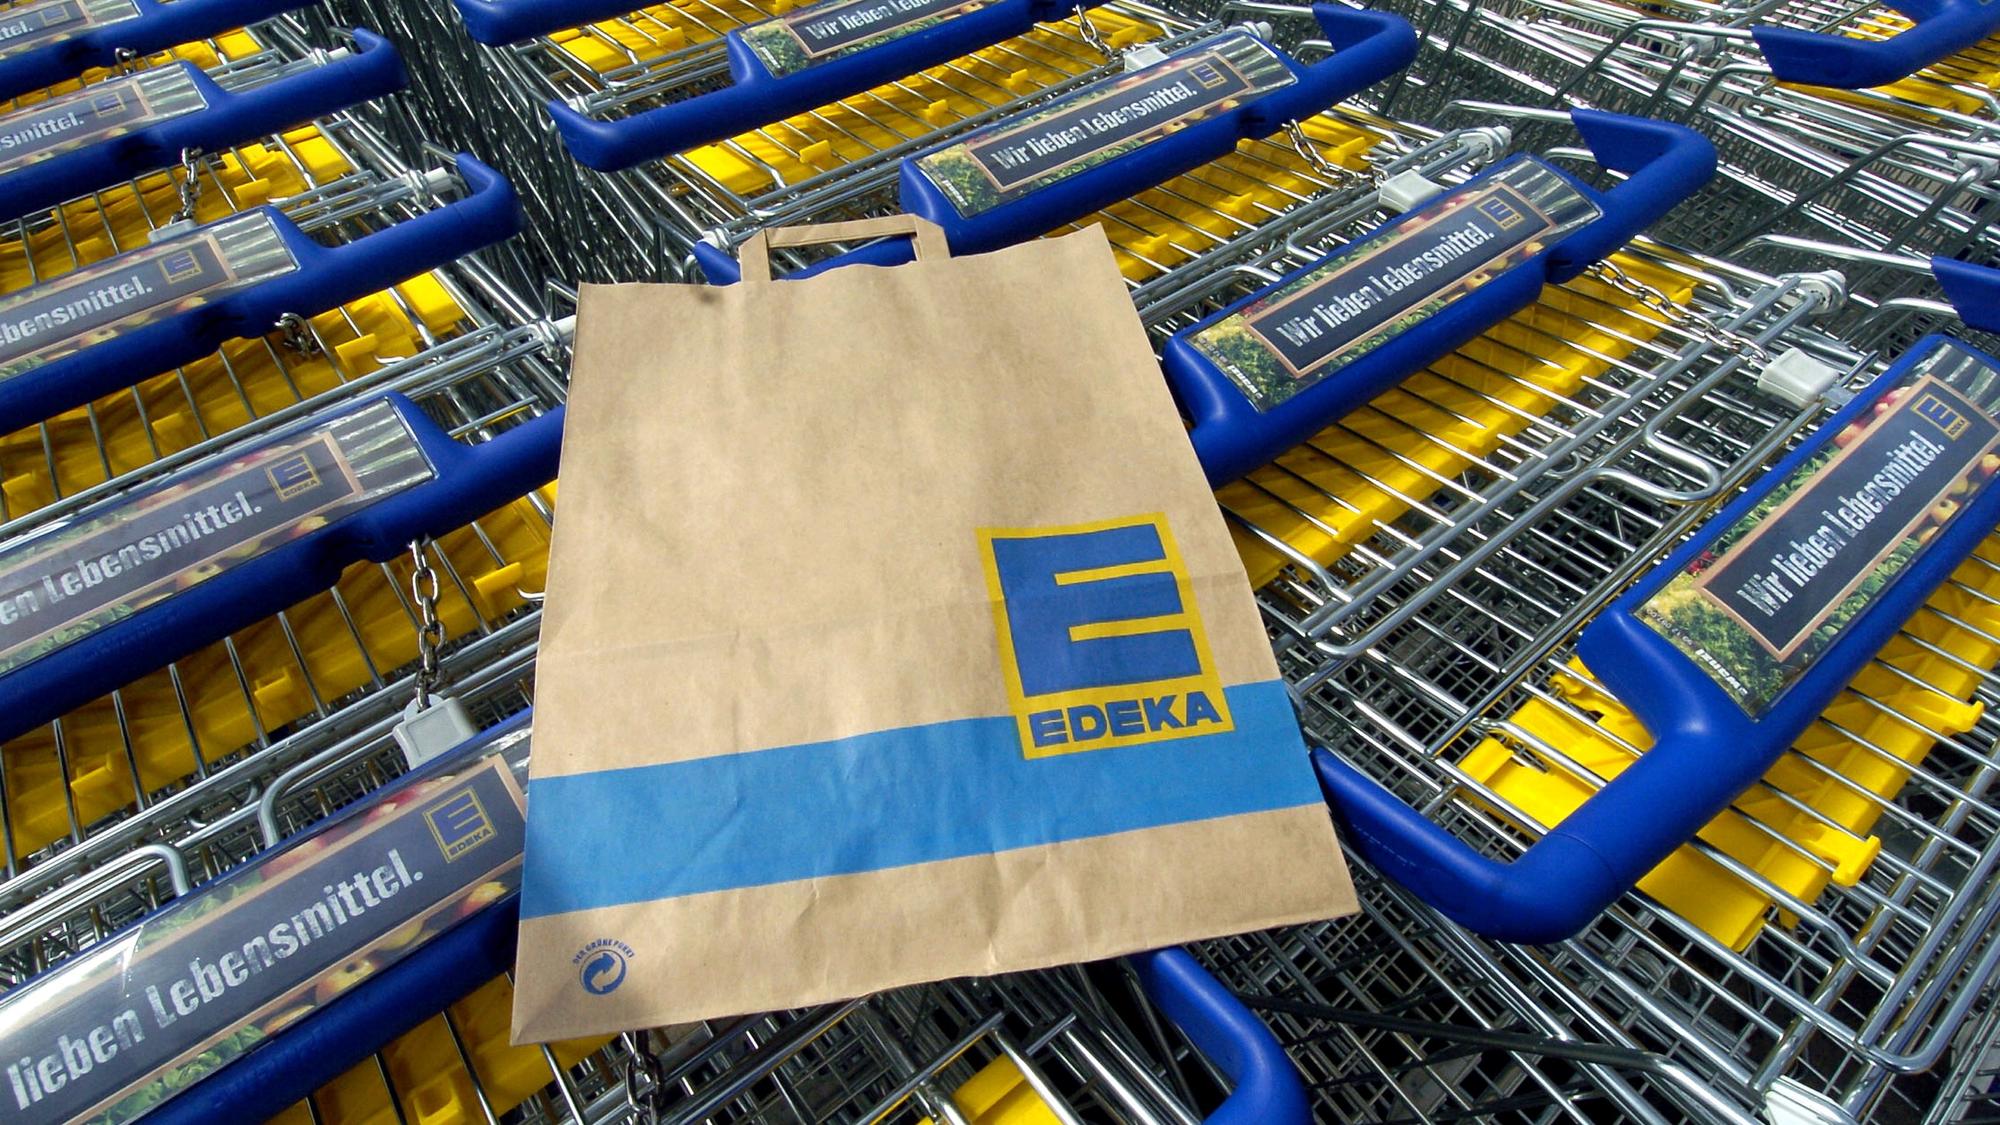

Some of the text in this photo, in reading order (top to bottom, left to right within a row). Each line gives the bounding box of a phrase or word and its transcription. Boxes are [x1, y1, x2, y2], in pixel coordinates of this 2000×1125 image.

[805, 21, 840, 40] Wir
[838, 5, 892, 32] lieben
[0, 112, 84, 151] smittel.
[991, 81, 1197, 169] Wir lieben Lebensmittel.
[1276, 221, 1495, 347] Wir lieben Lebensmittel.
[42, 491, 262, 604] Lebensmittel.
[1736, 430, 1945, 617] Wir lieben Lebensmittel.
[1028, 690, 1223, 748] EDEKA
[6, 849, 424, 1111] lieben Lebensmittel.
